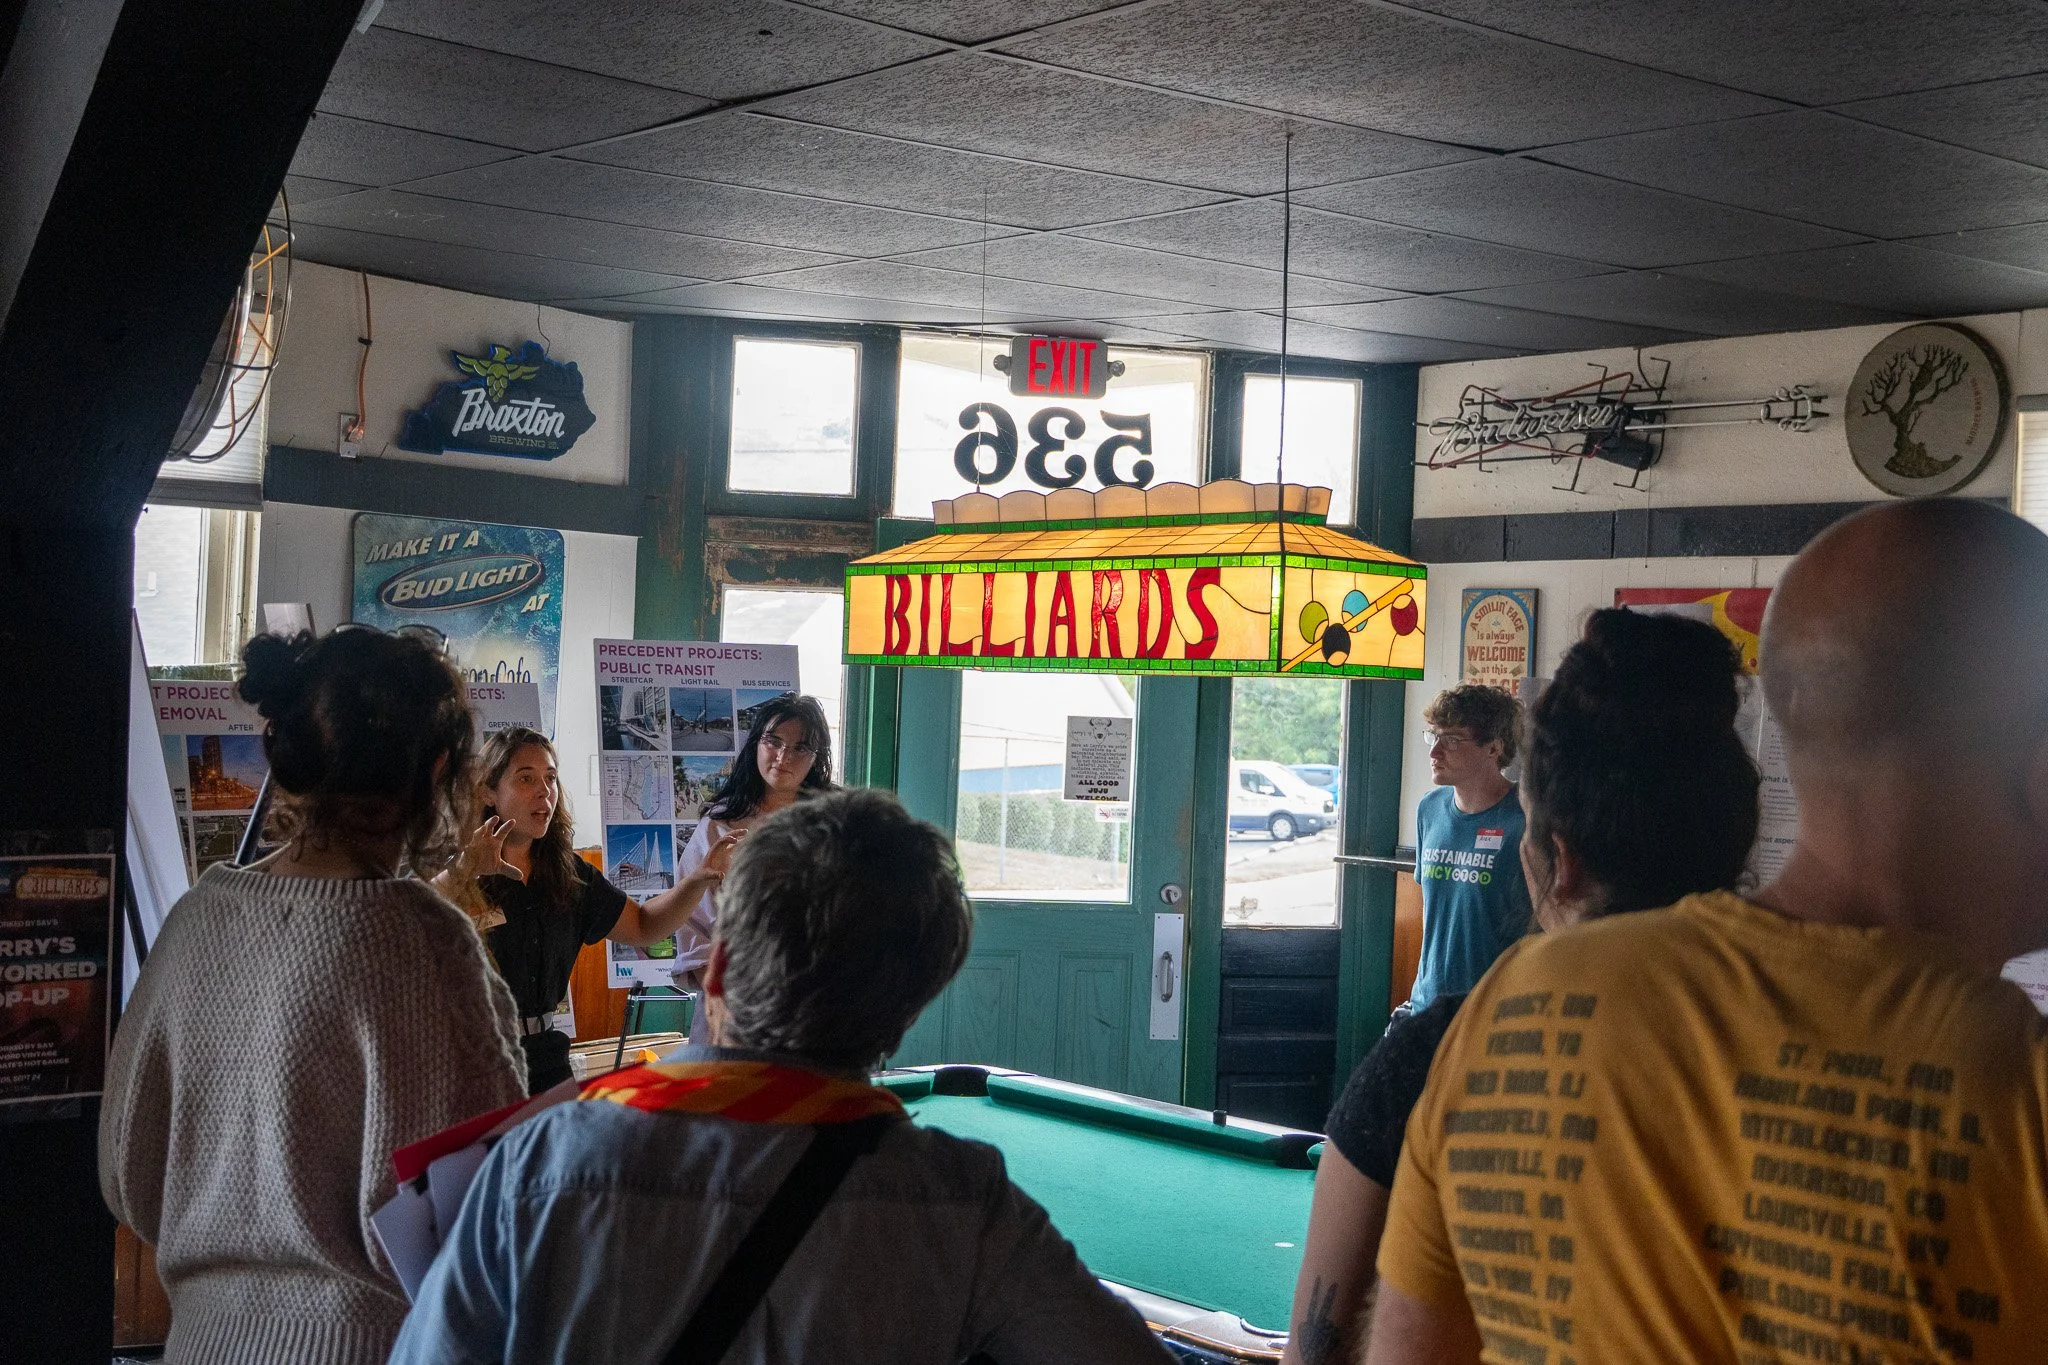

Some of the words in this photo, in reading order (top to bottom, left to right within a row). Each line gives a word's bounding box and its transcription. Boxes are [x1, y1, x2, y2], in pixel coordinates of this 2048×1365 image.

[1027, 338, 1097, 395] EXIT
[452, 387, 565, 439] Braxton
[489, 435, 546, 448] BREWING
[365, 536, 433, 564] MAKE
[437, 532, 460, 552] IT
[462, 529, 480, 549] A
[391, 576, 453, 603] BUD
[455, 562, 534, 592] LIGHT
[520, 593, 550, 614] AT
[882, 567, 1221, 660] BILLIARDS
[1470, 622, 1479, 631] A
[1506, 606, 1525, 632] FACE
[1477, 631, 1484, 640] is
[1486, 630, 1515, 645] always
[599, 644, 683, 658] PRECEDENT
[689, 648, 763, 661] PROJECTS:
[1467, 646, 1526, 662] WELCOME
[600, 662, 652, 675] PUBLIC
[655, 664, 715, 676] TRANSIT
[1481, 666, 1490, 674] at
[1491, 664, 1508, 675] this
[611, 676, 654, 684] STREETCAR
[742, 679, 756, 687] BUS
[167, 687, 230, 700] PROJEC
[160, 707, 227, 720] EMOVAL
[1423, 848, 1495, 870] SUSTAINABLE
[0, 960, 98, 983] ORKED
[0, 987, 70, 1008] P-UP
